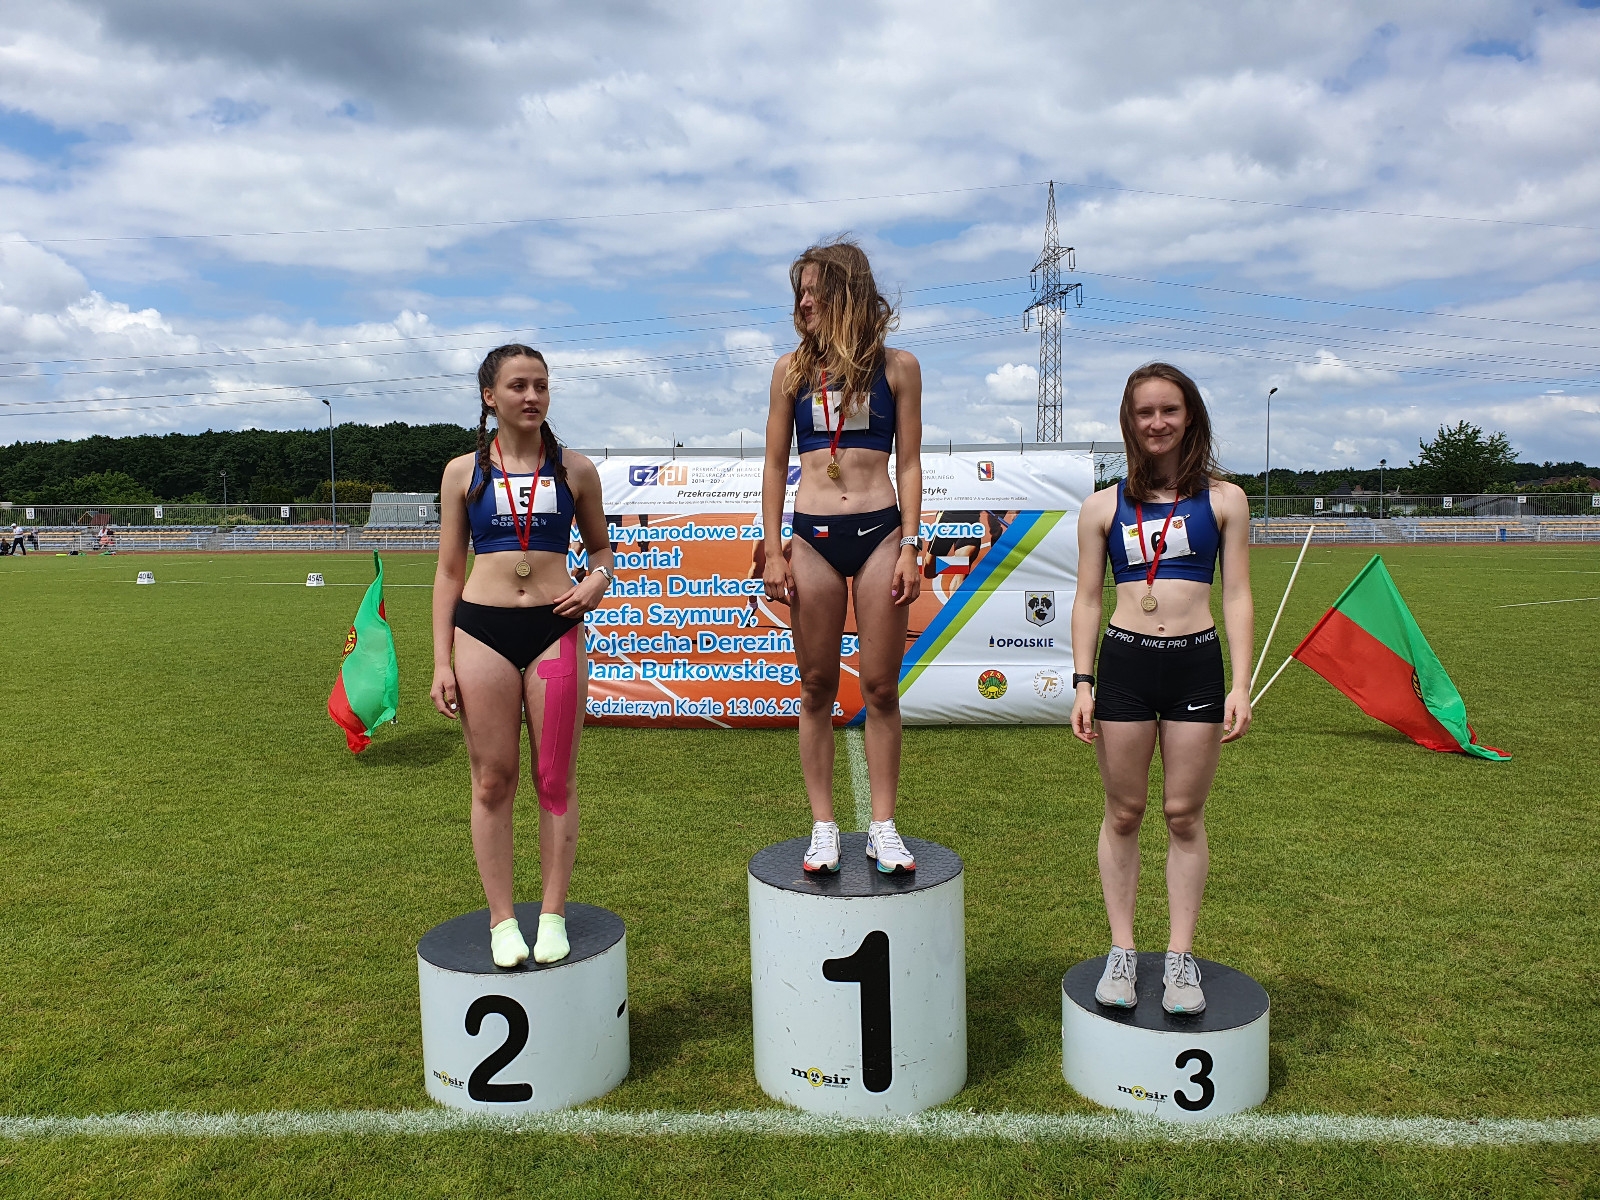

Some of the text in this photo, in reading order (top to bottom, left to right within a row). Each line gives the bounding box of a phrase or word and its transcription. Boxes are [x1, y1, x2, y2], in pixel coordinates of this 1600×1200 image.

[519, 487, 532, 507] 5
[677, 490, 741, 499] Przekraczamy
[1150, 531, 1168, 554] 6
[669, 576, 765, 595] Durkacz
[649, 604, 757, 627] Szymury,
[997, 638, 1054, 648] OPOLSKIE
[1114, 631, 1135, 643] PRO
[1141, 638, 1166, 649] NIKE
[1167, 639, 1188, 649] PRO
[1195, 630, 1215, 645] NIKE
[676, 699, 722, 714] Koźle
[728, 699, 801, 715] 13.06.20
[822, 930, 893, 1092] 1
[465, 994, 533, 1103] 2
[1173, 1048, 1215, 1111] 3
